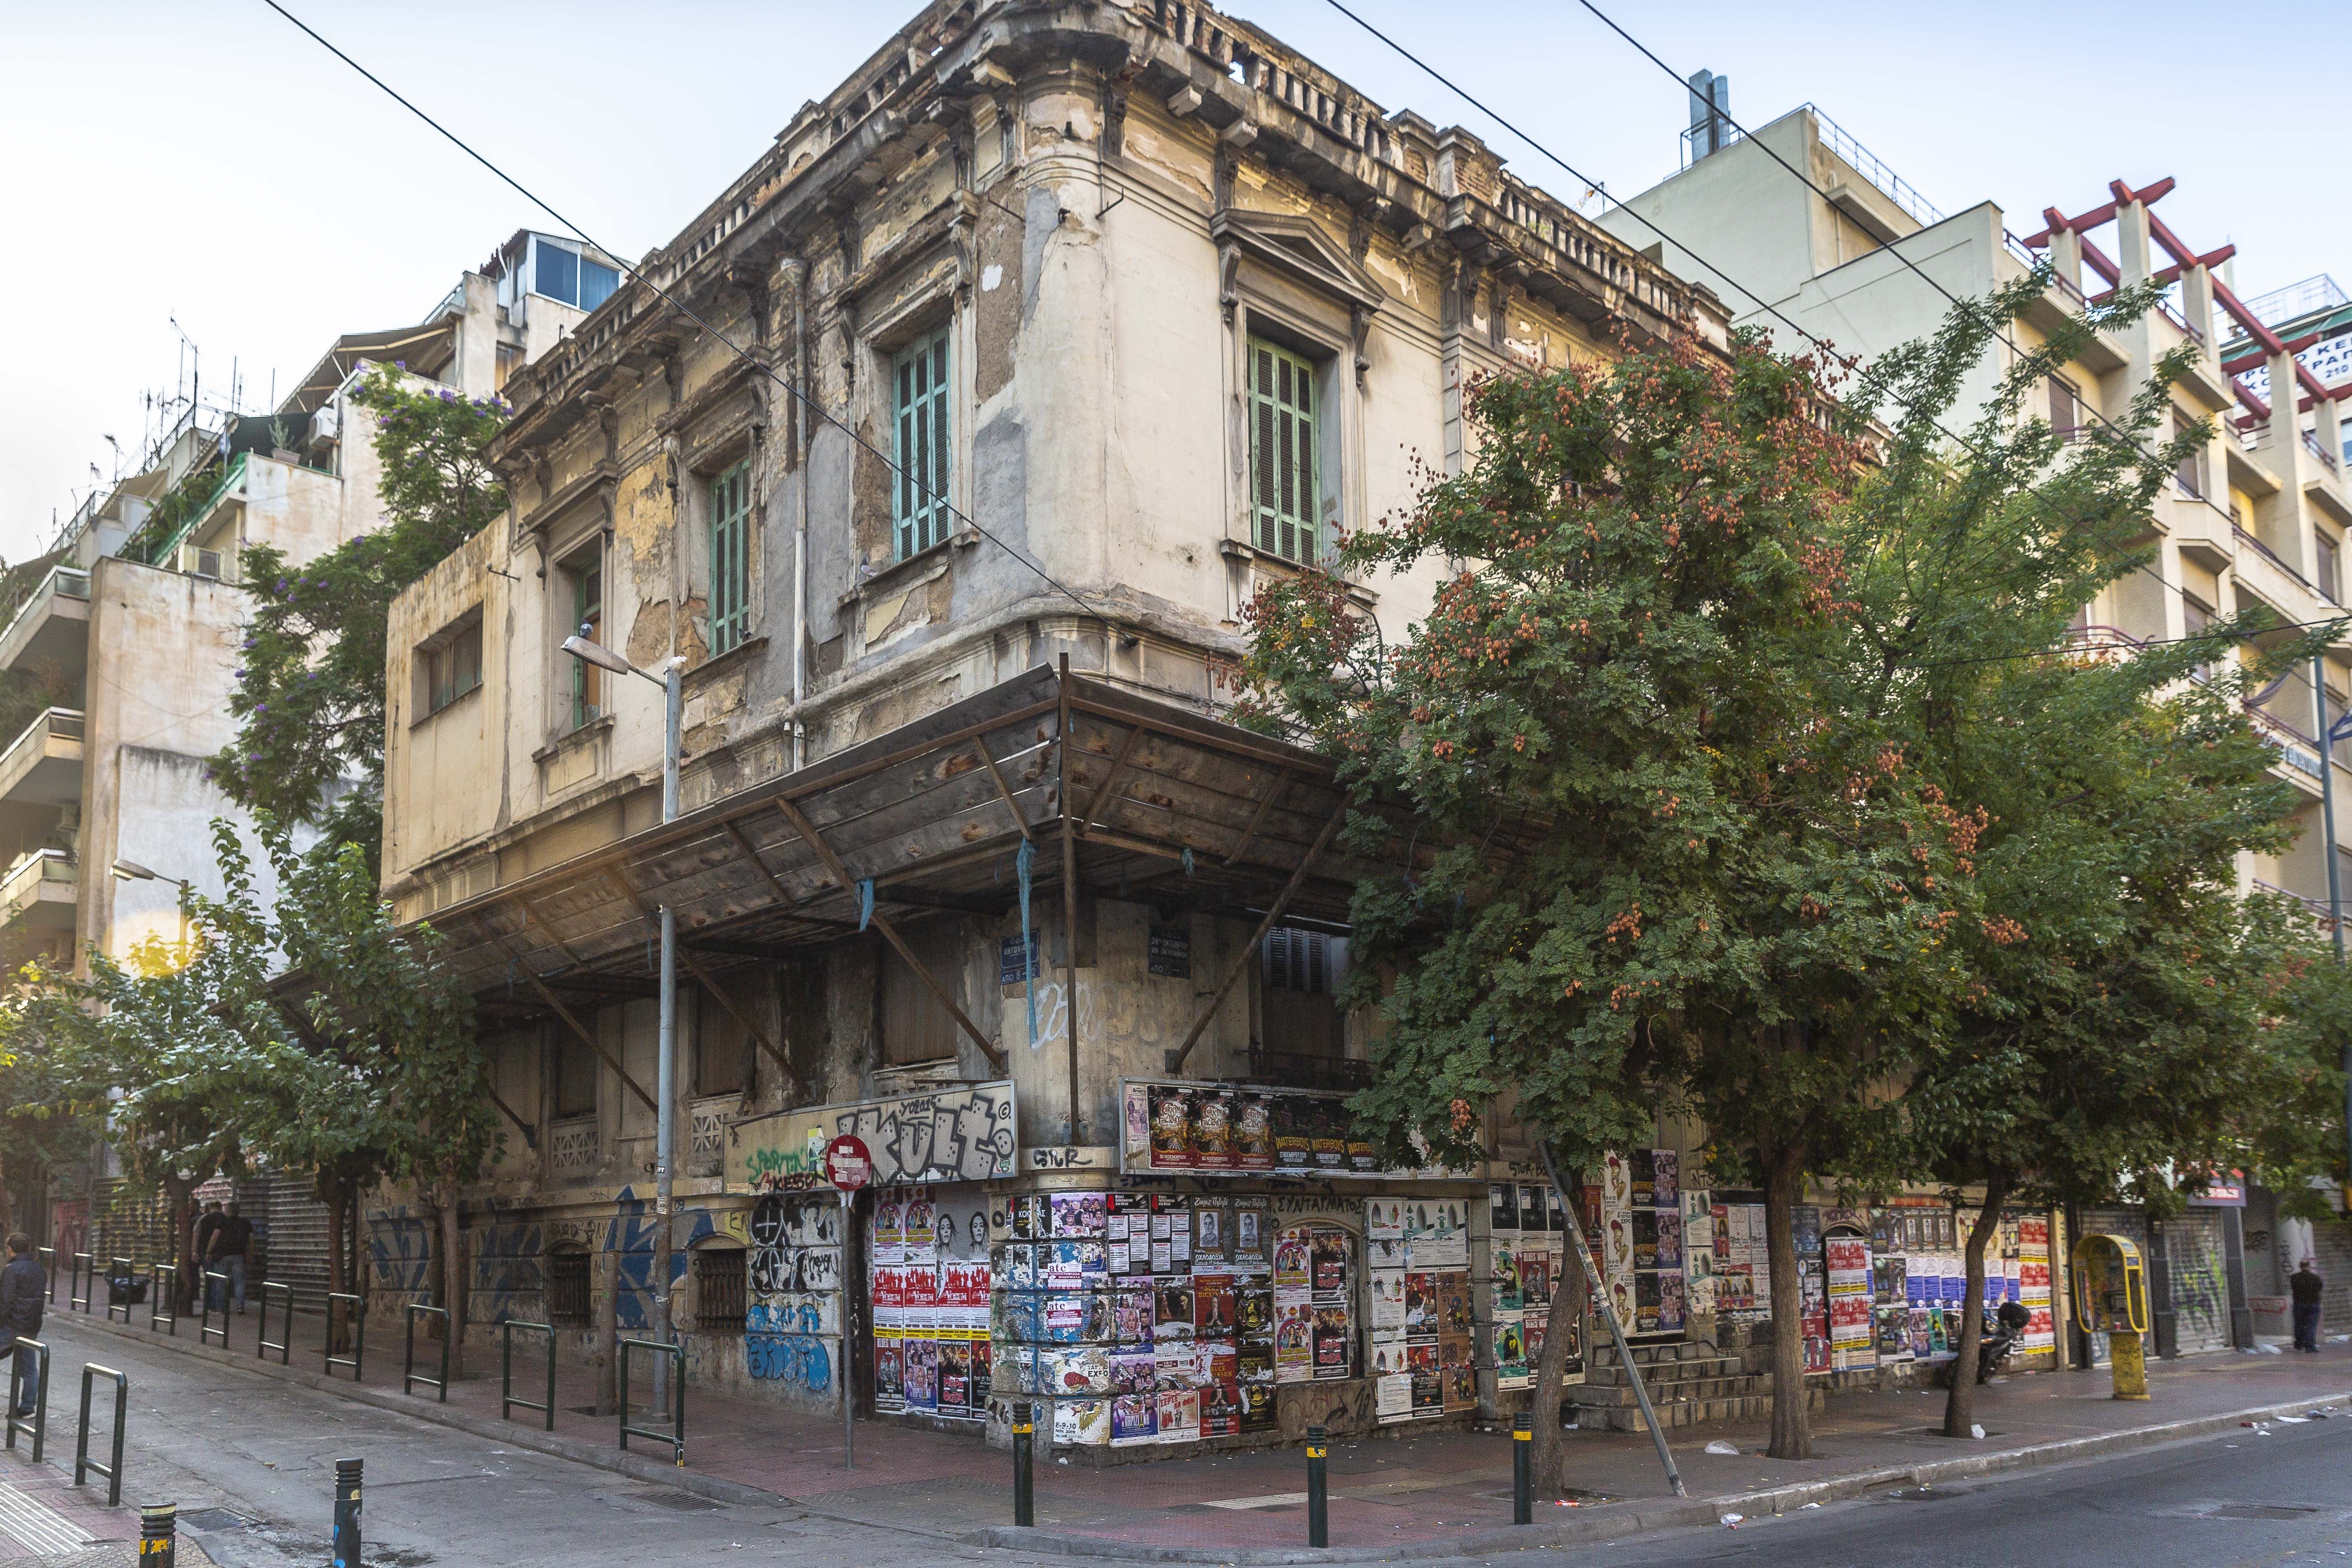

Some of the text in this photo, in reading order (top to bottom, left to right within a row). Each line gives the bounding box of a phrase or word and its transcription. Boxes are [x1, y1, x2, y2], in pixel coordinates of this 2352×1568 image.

[1278, 1195, 1362, 1214] ΣΥΝΤΑΓΜΑΤΟΣ
[1049, 1264, 1066, 1272] atc
[1049, 1302, 1065, 1311] atc
